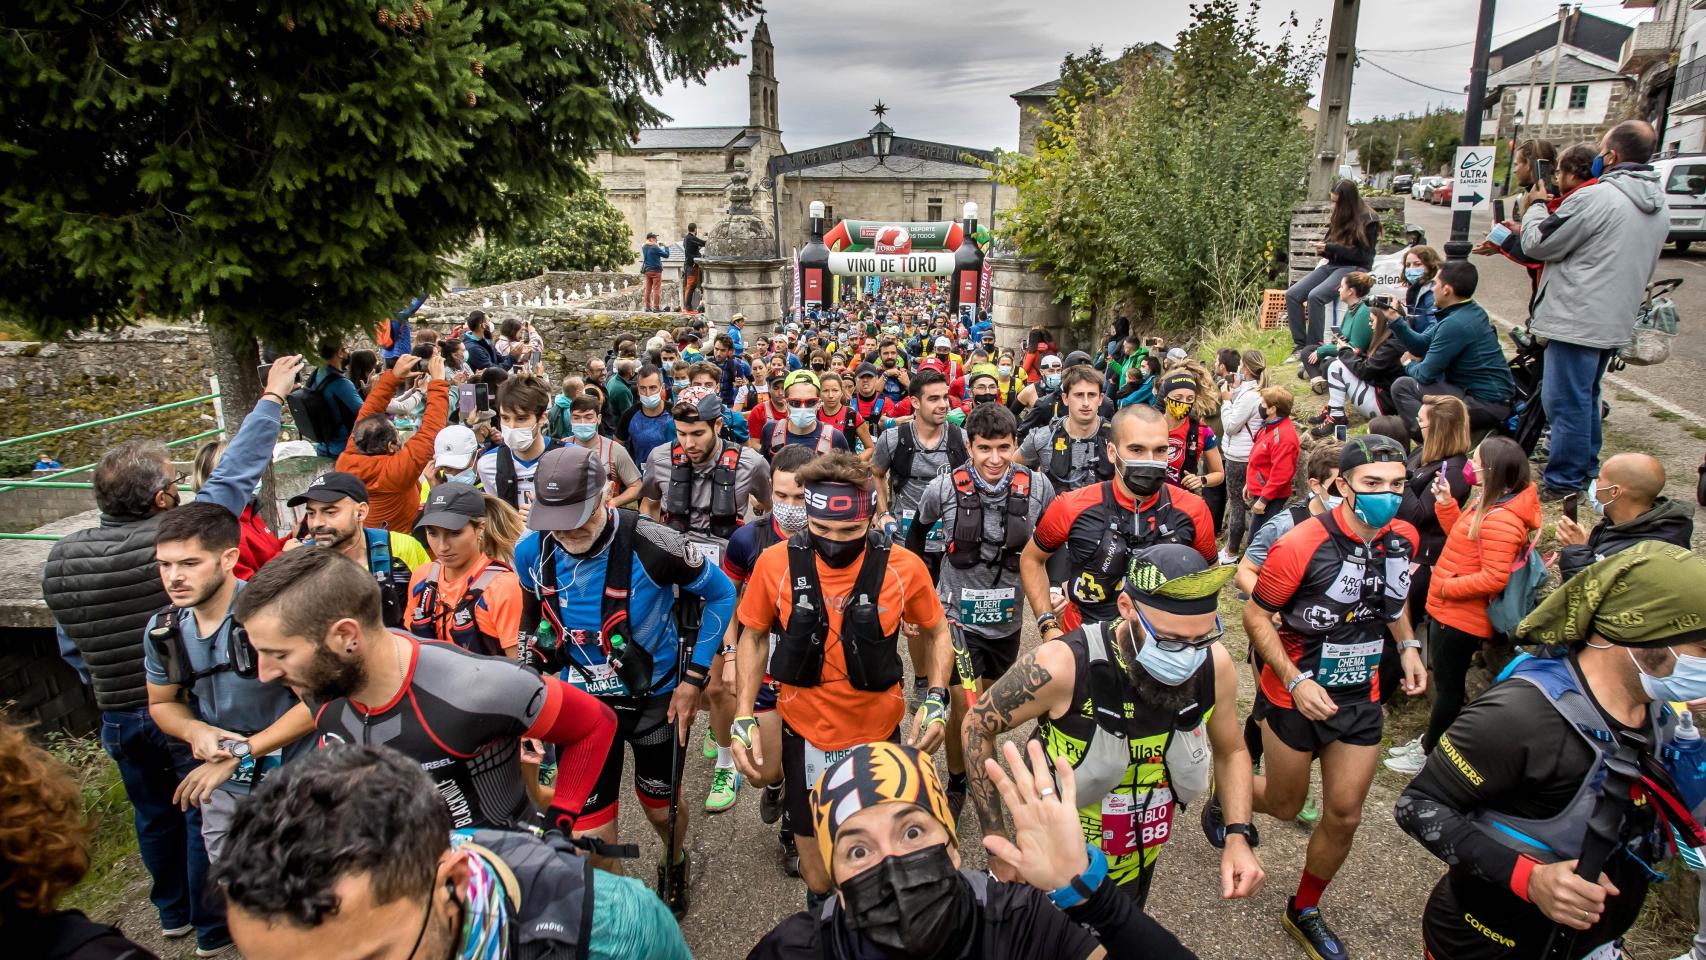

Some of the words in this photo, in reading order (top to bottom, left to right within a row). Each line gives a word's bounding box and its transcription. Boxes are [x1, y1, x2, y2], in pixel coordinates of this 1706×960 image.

[1460, 170, 1487, 178] ULTRA
[847, 258, 876, 273] VINO
[880, 258, 895, 273] DE
[900, 256, 937, 273] TORO
[1339, 575, 1361, 588] ARC
[1341, 585, 1360, 597] MA
[974, 600, 1001, 609] ALBERT
[971, 612, 1002, 624] 1433
[1337, 656, 1366, 668] CHEMA
[1327, 671, 1367, 686] 2435
[1125, 821, 1169, 848] 288
